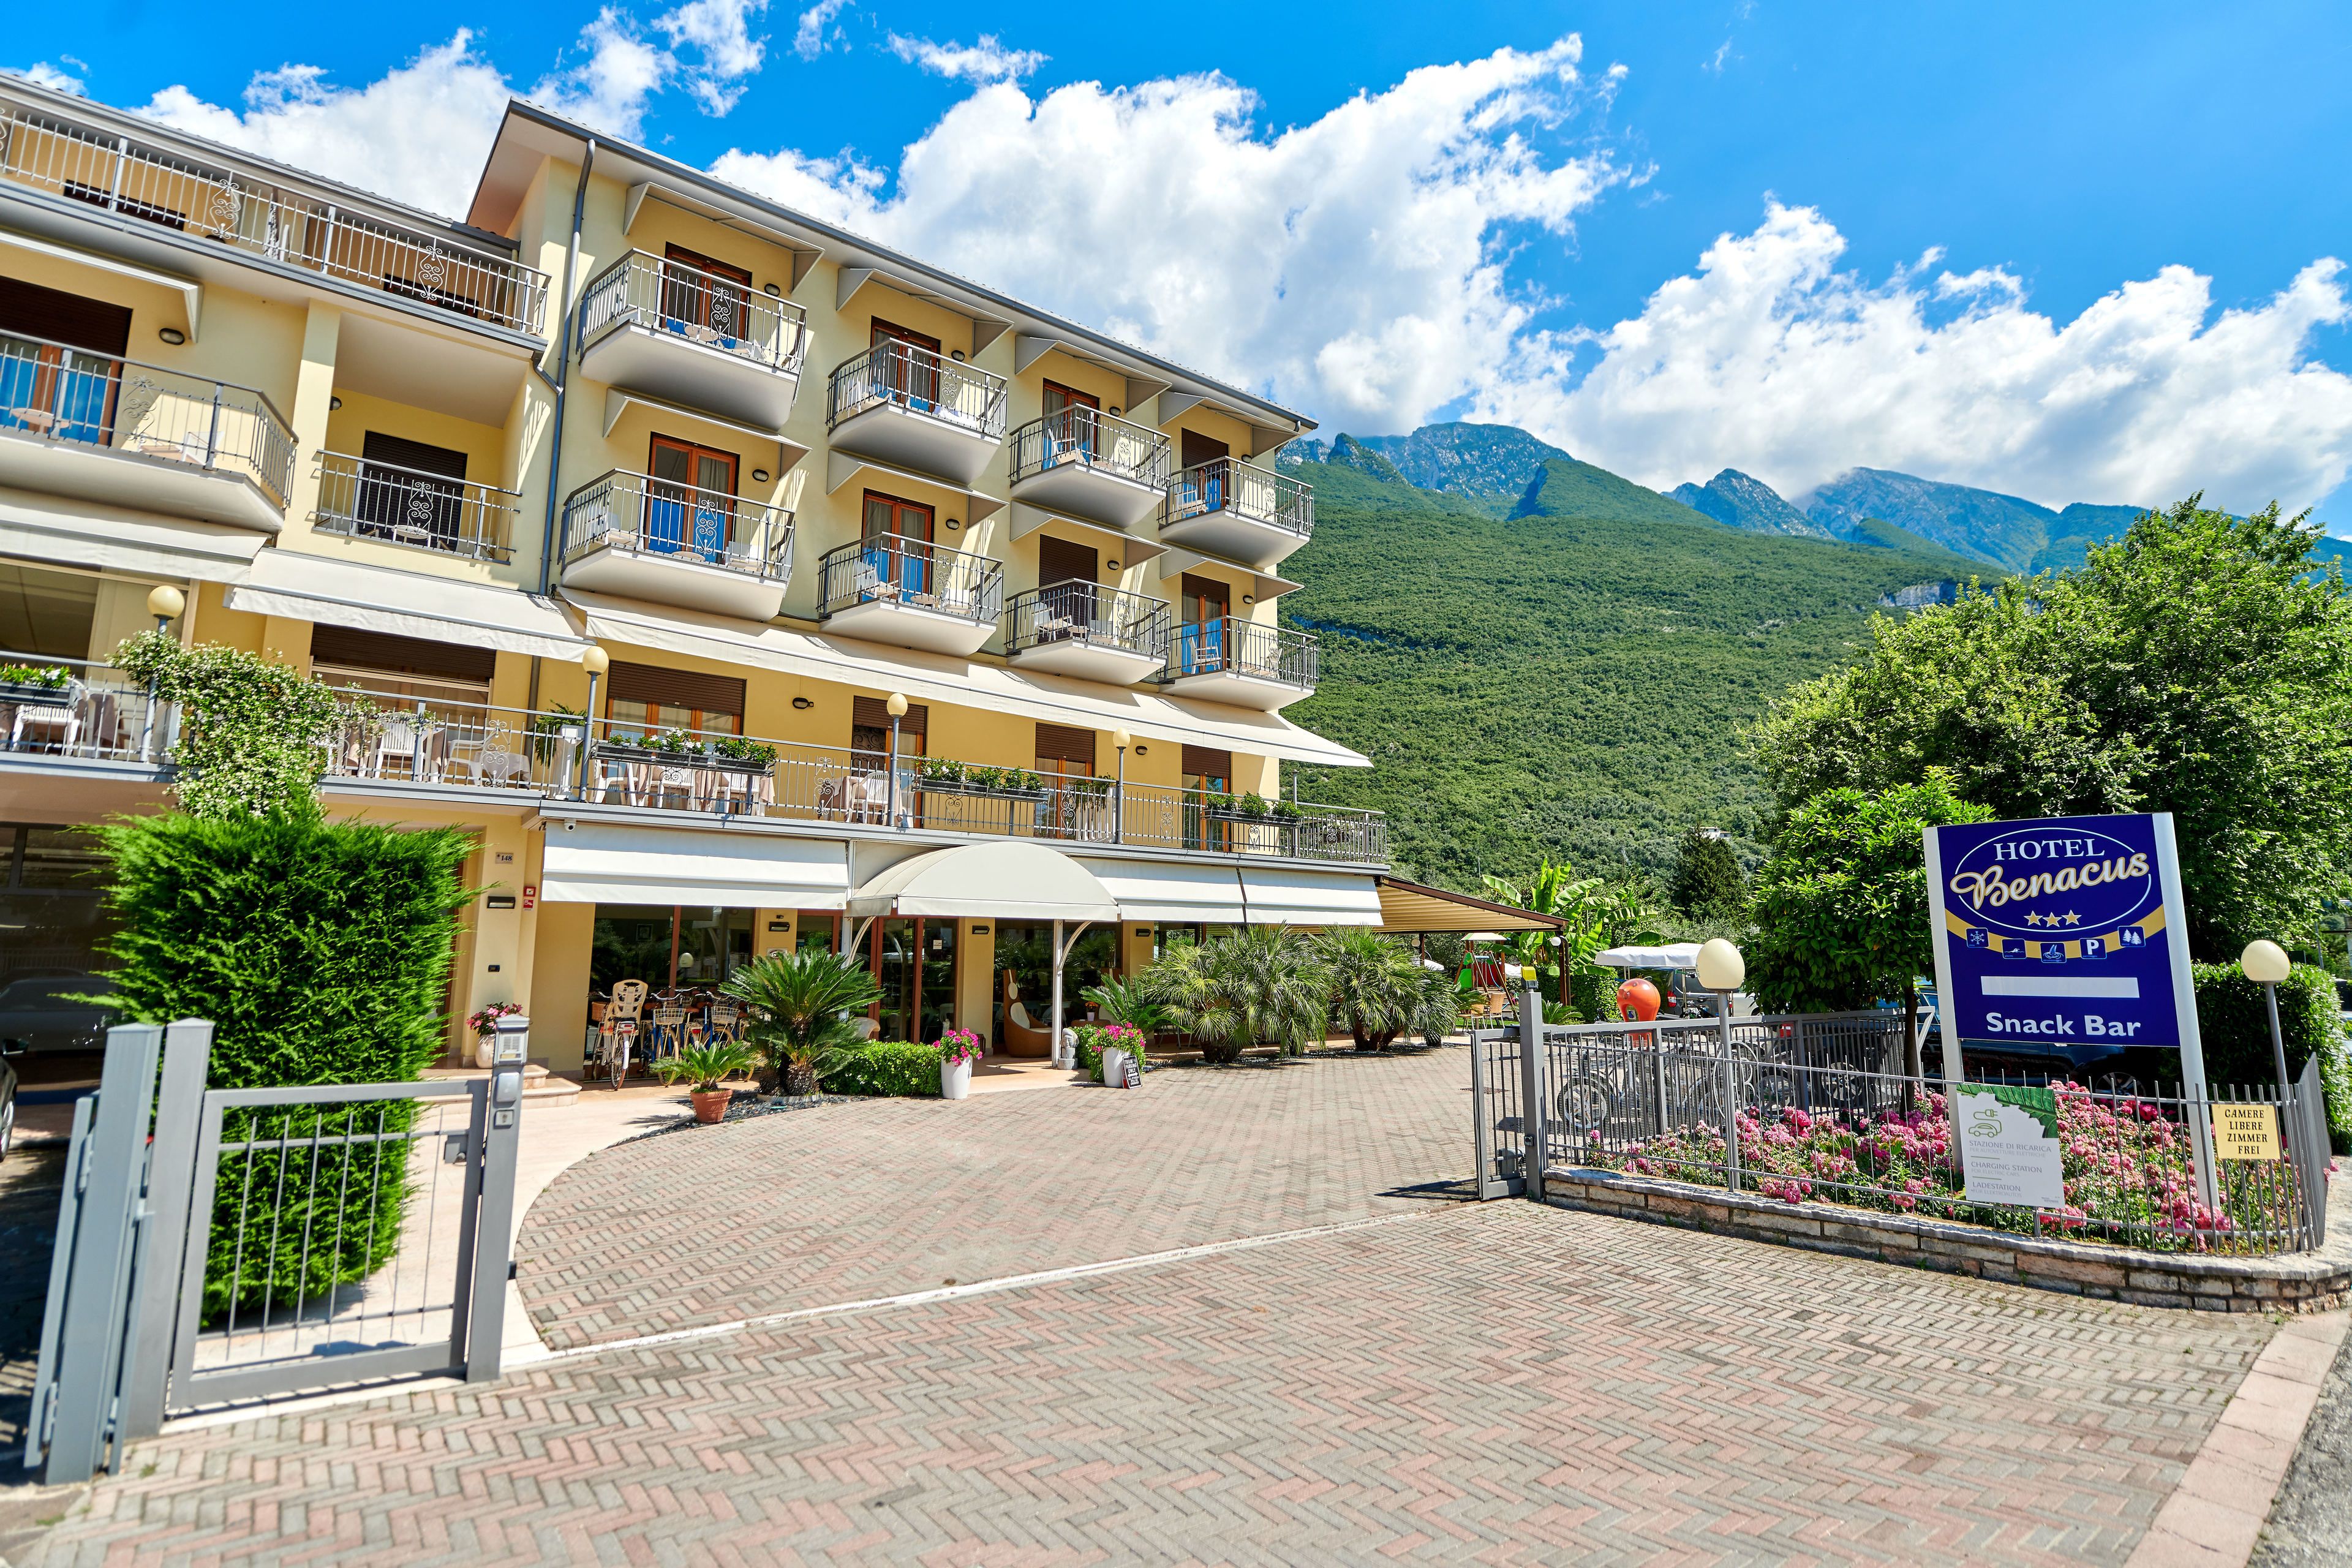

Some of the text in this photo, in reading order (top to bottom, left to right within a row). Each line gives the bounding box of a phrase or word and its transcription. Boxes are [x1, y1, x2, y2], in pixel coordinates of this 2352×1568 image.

[1994, 839, 2105, 861] HOTEL
[1950, 852, 2149, 910] Benacus
[2086, 939, 2100, 955] P
[1986, 1012, 2141, 1036] Snack Bar
[2225, 1109, 2264, 1118] CAMERE
[2230, 1121, 2263, 1130] LIBERE
[2227, 1134, 2267, 1142] ZIMMER
[2016, 1144, 2051, 1152] RICARICA
[1971, 1161, 2010, 1170] CHARGING
[1972, 1182, 2021, 1191] LADESTATION
